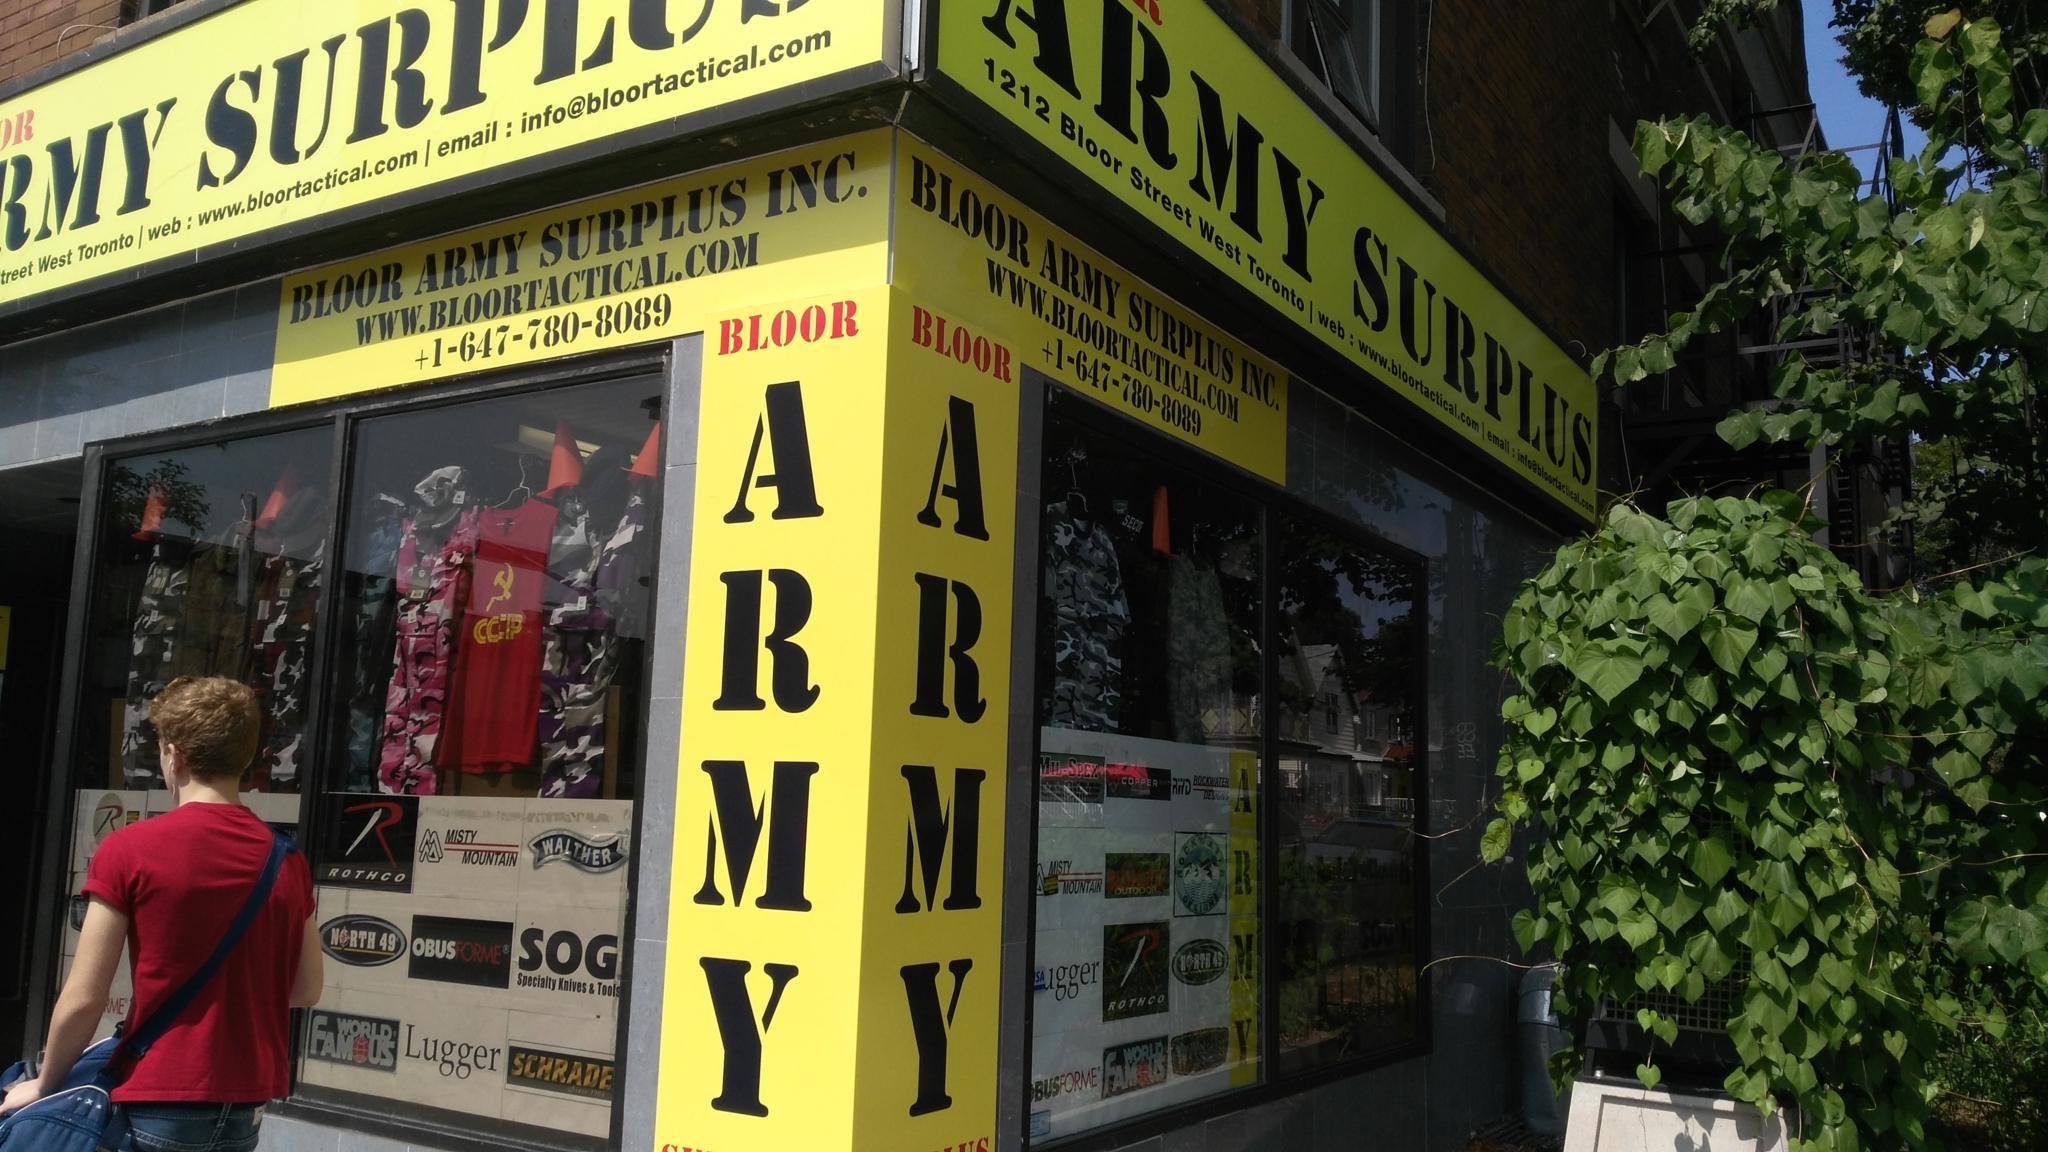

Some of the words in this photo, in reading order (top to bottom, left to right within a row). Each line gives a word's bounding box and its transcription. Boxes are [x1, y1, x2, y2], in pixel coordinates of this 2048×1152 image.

[0, 97, 178, 252] RMY
[196, 0, 809, 193] SURPL
[0, 261, 33, 285] treet
[38, 249, 72, 274] West
[78, 232, 134, 262] Toronto
[147, 216, 181, 242] web
[198, 149, 418, 227] www.bloortactical.com
[437, 120, 498, 158] email
[521, 30, 832, 134] info@bloortactical.com
[289, 262, 403, 324] BLOOR
[414, 230, 528, 295] ARMY
[539, 178, 747, 268] SURPLUS
[765, 151, 867, 218] INC.
[356, 232, 760, 346] WWW.BLOORTACTICAL.COM
[910, 155, 1030, 268] BLOOR
[1039, 238, 1121, 319] ARMY
[1128, 291, 1234, 384] SURPLUS
[1240, 358, 1279, 411] INC.
[984, 57, 1050, 124] 1212
[1060, 112, 1122, 175] Bloor
[1130, 166, 1192, 228] Street
[1199, 215, 1240, 266] West
[1247, 253, 1304, 312] Toronto
[1318, 309, 1345, 339] web
[1358, 339, 1479, 433] www.bloortactical.com
[1487, 429, 1510, 454] email
[1517, 454, 1595, 515] info@bloortactical.com
[415, 293, 672, 370] +1-647-780-8089
[718, 300, 859, 355] BLOOR
[911, 305, 1012, 383] BLOOR
[986, 257, 1239, 423] WWW.BLOORTACTICAL.COM
[1353, 227, 1592, 486] SURPLUS
[1042, 337, 1202, 437] +1-647-780-8089
[1193, 774, 1230, 789] ROCKWATER
[1203, 789, 1229, 801] DESIGNS
[445, 829, 478, 844] MISTY
[541, 836, 612, 866] WALTHER
[328, 867, 406, 883] ROTHCO
[461, 851, 519, 867] MOUNTAIN
[1049, 860, 1073, 875] MISTY
[1062, 881, 1102, 895] MOUNTAIN
[1114, 885, 1157, 895] OUTDOOR
[331, 925, 376, 950] NORTH
[379, 931, 396, 952] 49
[518, 928, 618, 980] SOG
[517, 972, 556, 991] Specialty
[558, 976, 587, 994] Knives
[597, 981, 621, 998] Tools
[1045, 960, 1099, 1001] ugger
[1108, 994, 1165, 1012] ROTHCO
[310, 1014, 396, 1068] FAMOUS
[337, 1017, 392, 1039] WORLD
[404, 1024, 501, 1080] Lugger
[511, 1052, 614, 1091] SCHRADE
[1124, 1041, 1165, 1064] WORLD
